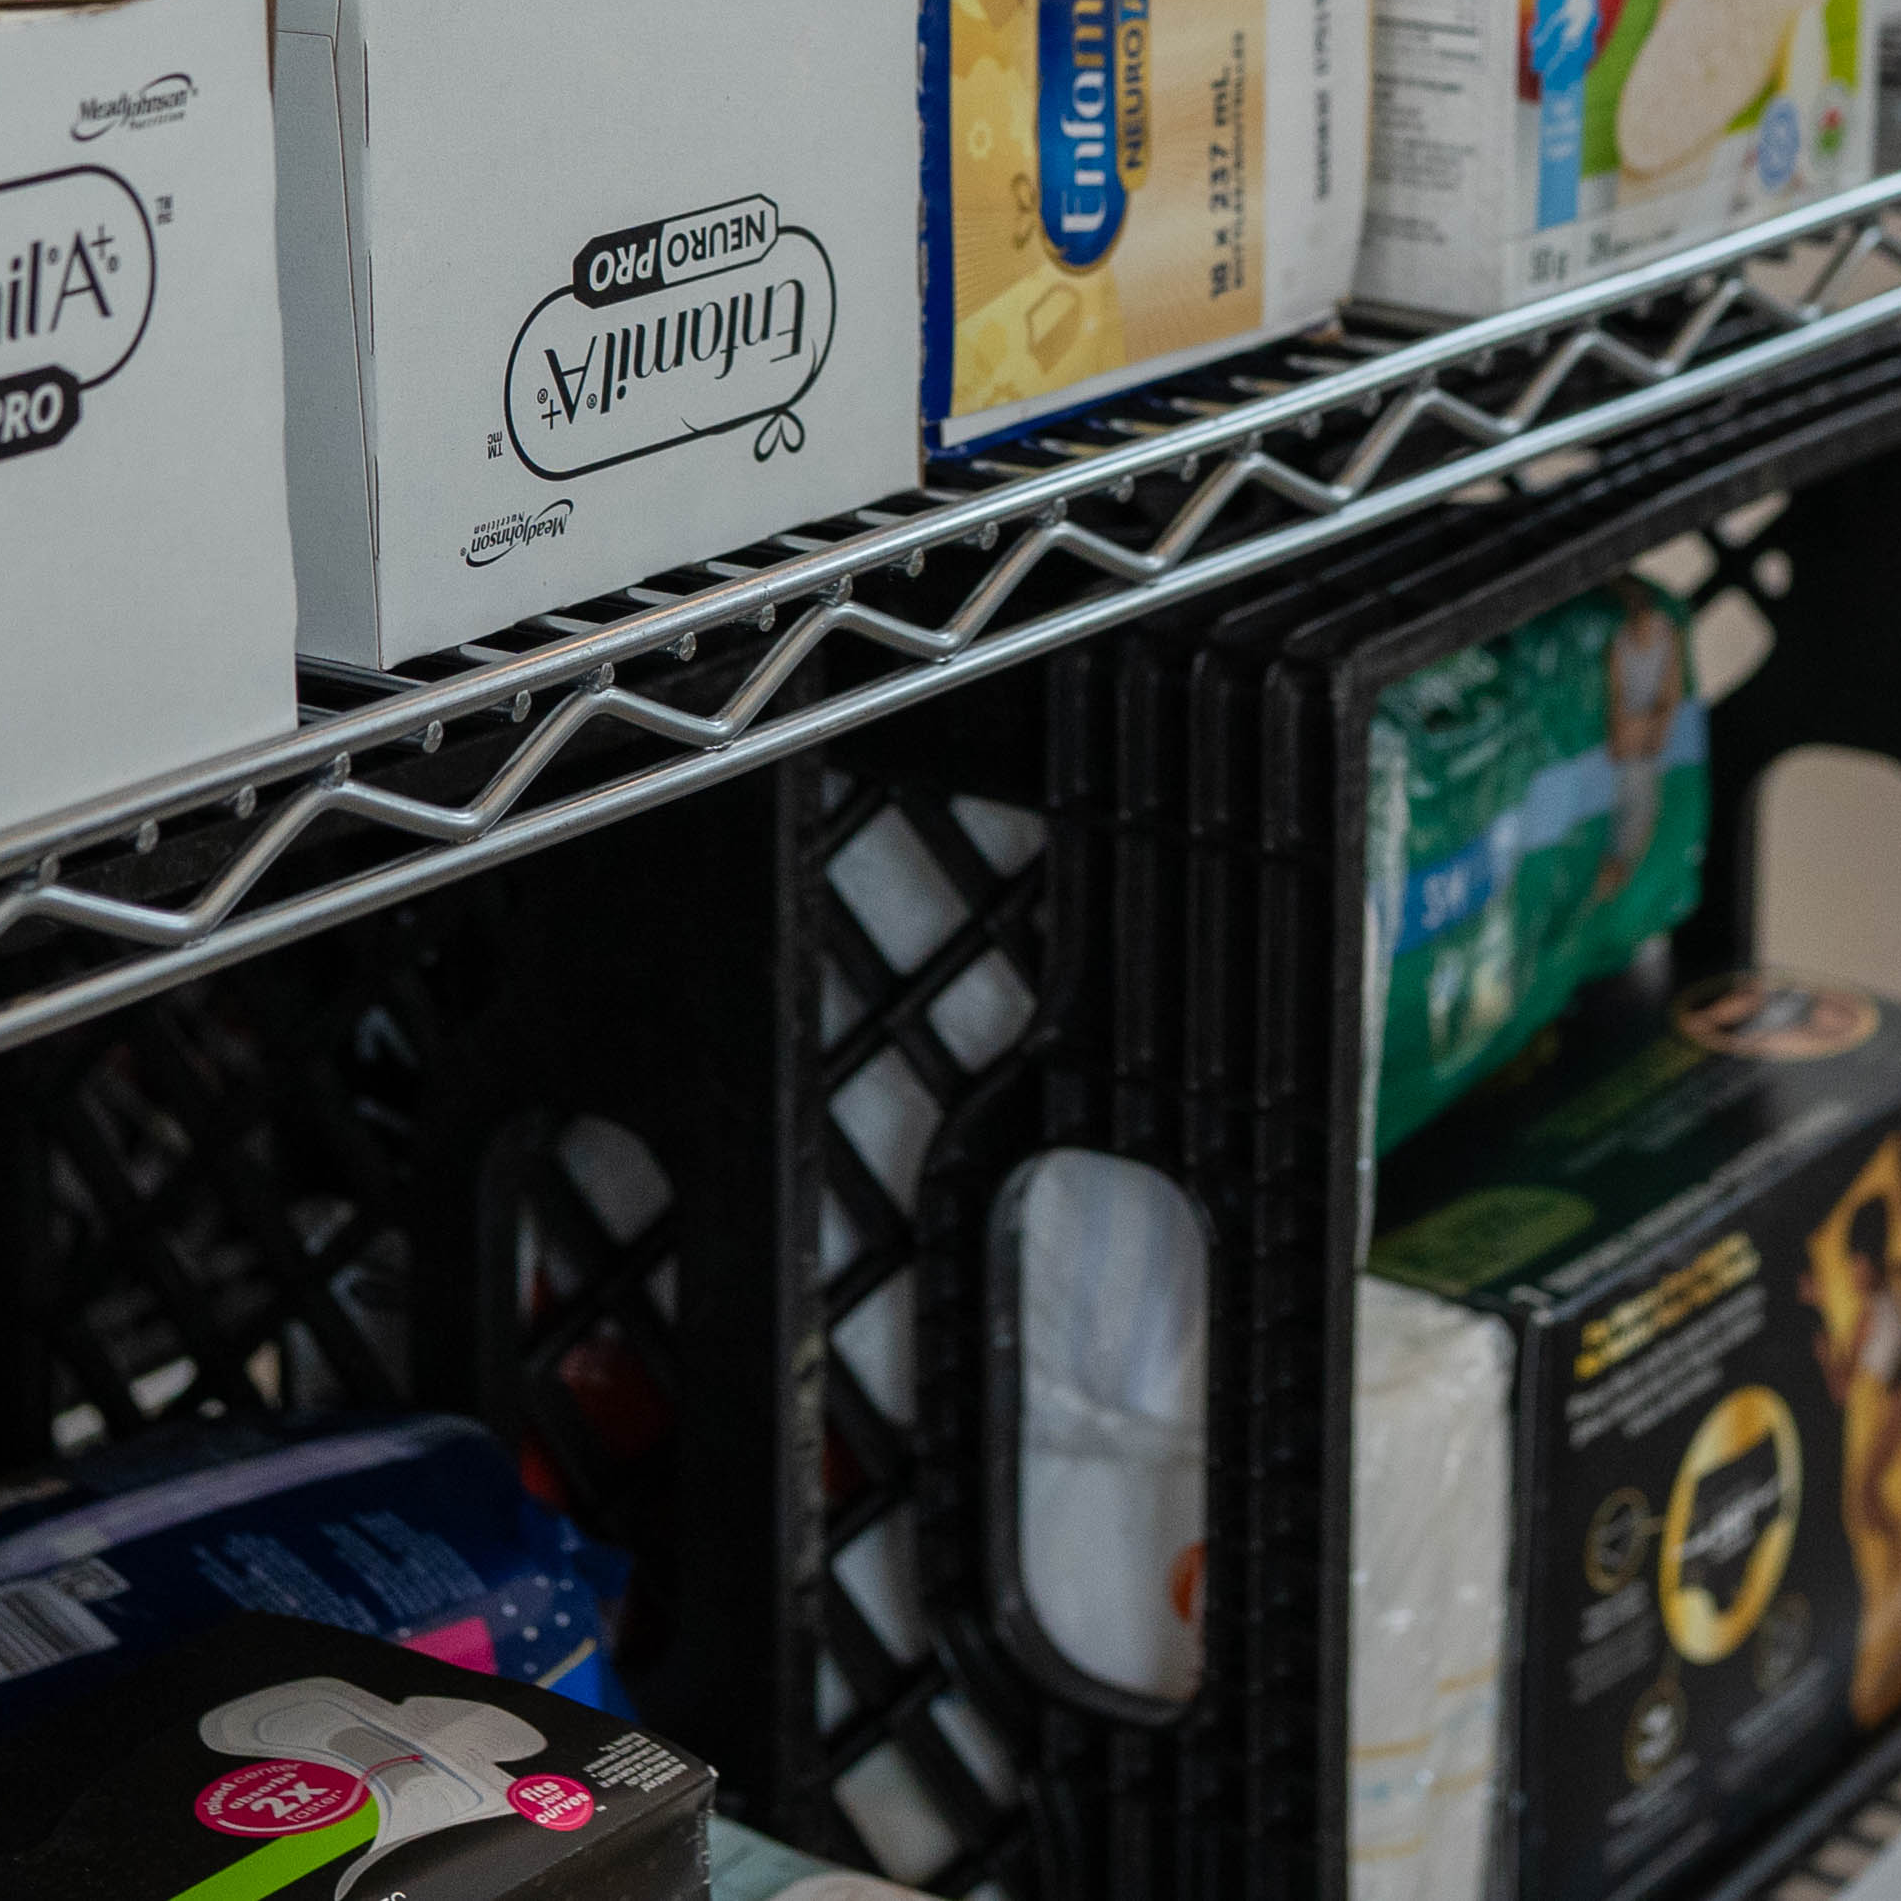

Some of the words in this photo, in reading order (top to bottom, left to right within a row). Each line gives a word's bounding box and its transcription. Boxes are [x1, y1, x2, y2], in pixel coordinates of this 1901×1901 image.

[1122, 28, 1145, 170] NEURO
[667, 211, 766, 269] NEURO
[589, 238, 657, 292] PRO
[474, 511, 525, 535] Nutrition
[228, 1772, 297, 1810] absorbs
[249, 1780, 330, 1819] 2X
[519, 1781, 560, 1802] fits
[534, 1791, 591, 1824] curves
[537, 1790, 567, 1809] your
